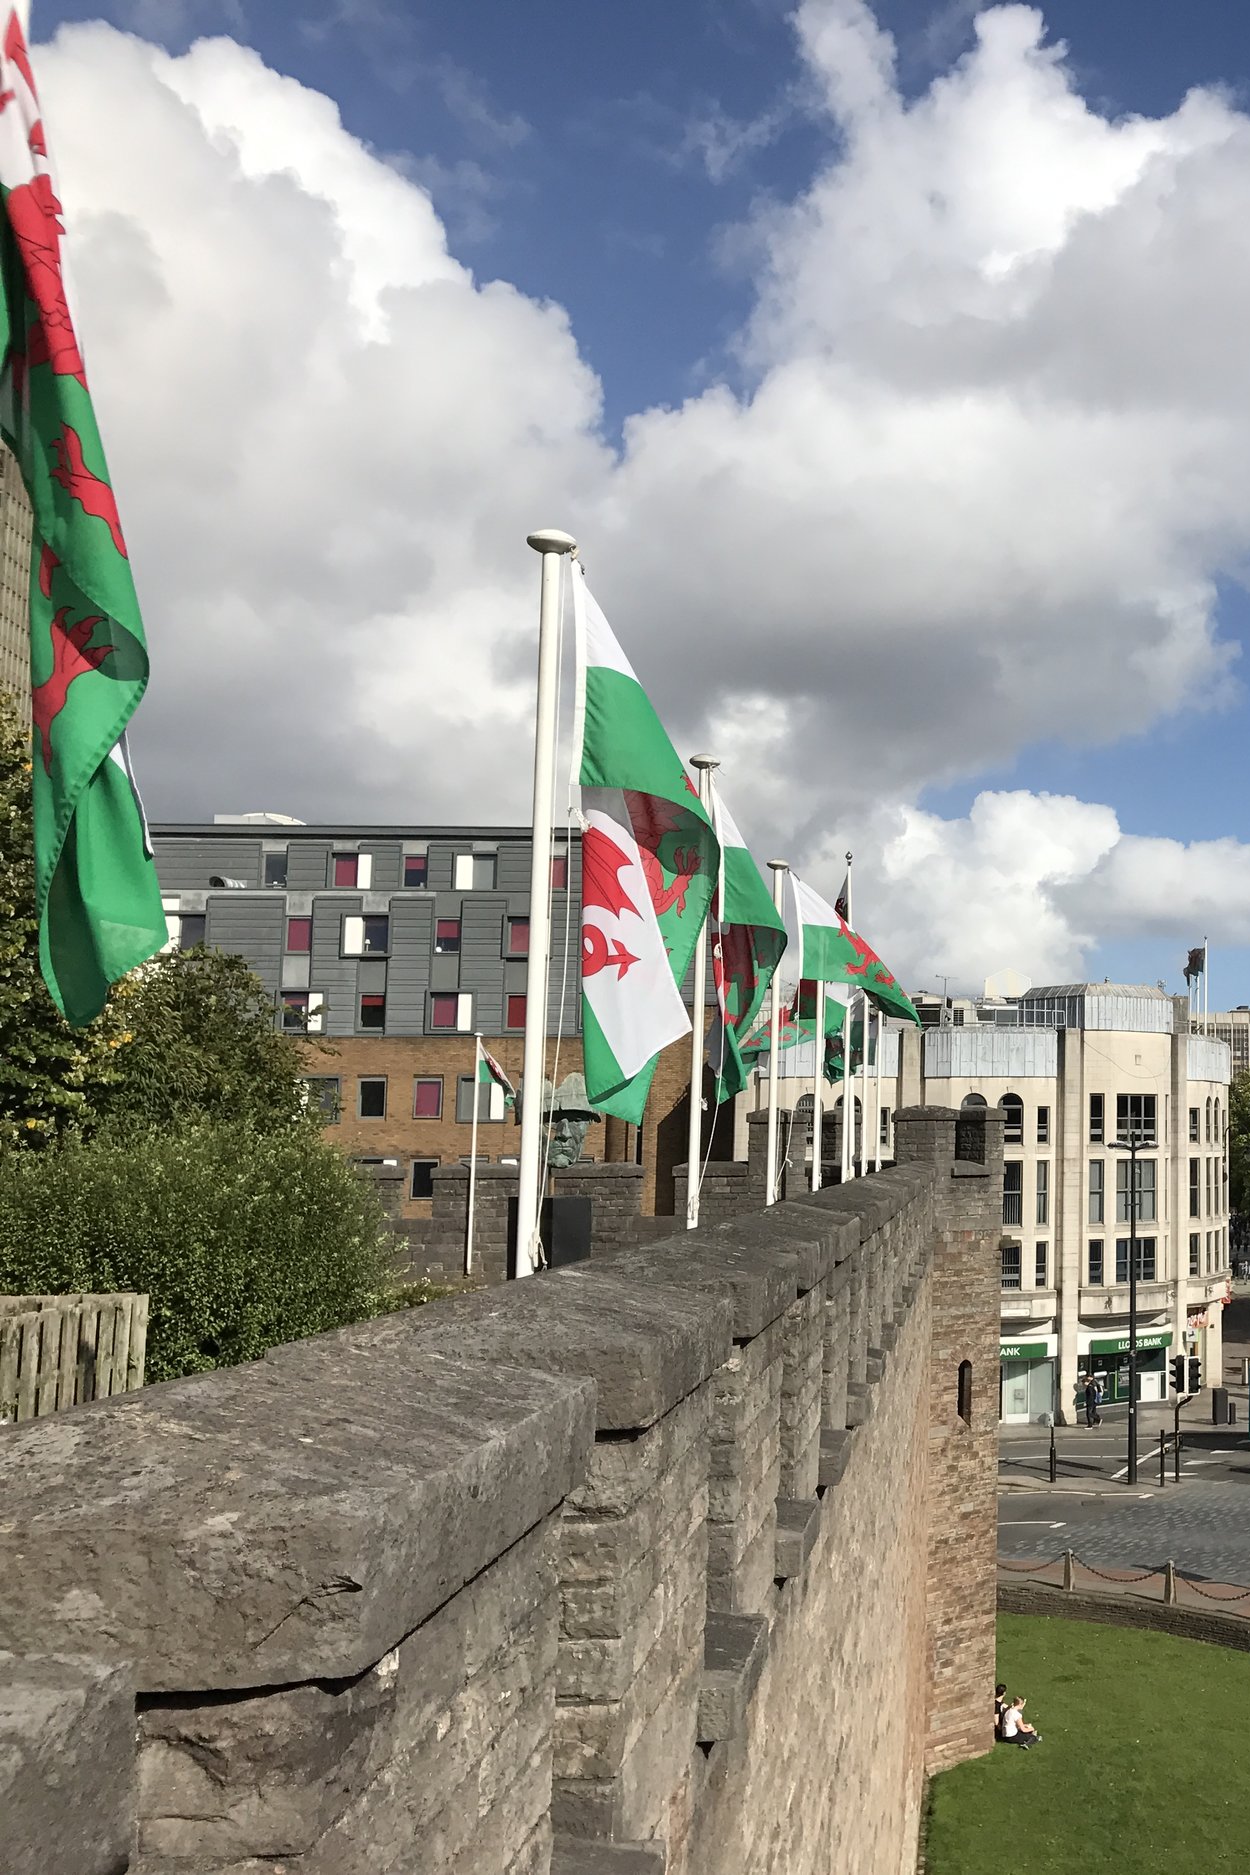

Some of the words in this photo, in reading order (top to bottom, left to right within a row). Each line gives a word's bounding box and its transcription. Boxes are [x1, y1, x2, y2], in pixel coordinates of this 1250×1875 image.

[1118, 1339, 1143, 1350] LLODS
[1143, 1337, 1162, 1347] BANK
[999, 1347, 1021, 1357] ANK
